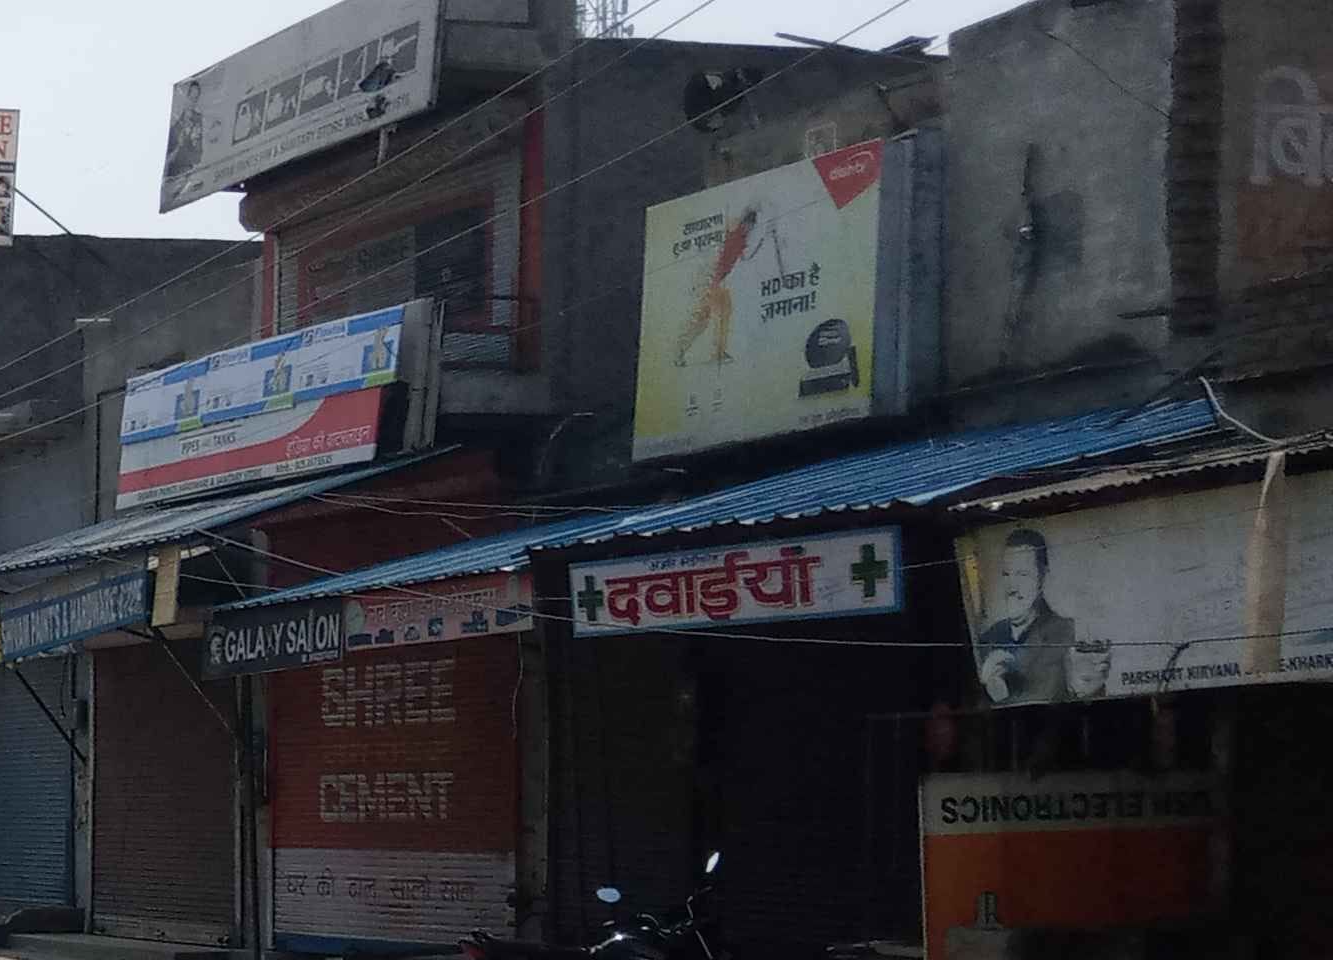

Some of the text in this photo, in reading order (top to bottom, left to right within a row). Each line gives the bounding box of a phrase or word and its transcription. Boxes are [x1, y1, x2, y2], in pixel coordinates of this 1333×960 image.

[760, 262, 821, 298] HD का है
[285, 609, 341, 654] SALON
[321, 659, 455, 727] SHREE
[320, 772, 453, 822] CEMENT
[940, 790, 1145, 824] ELECTRONICS
